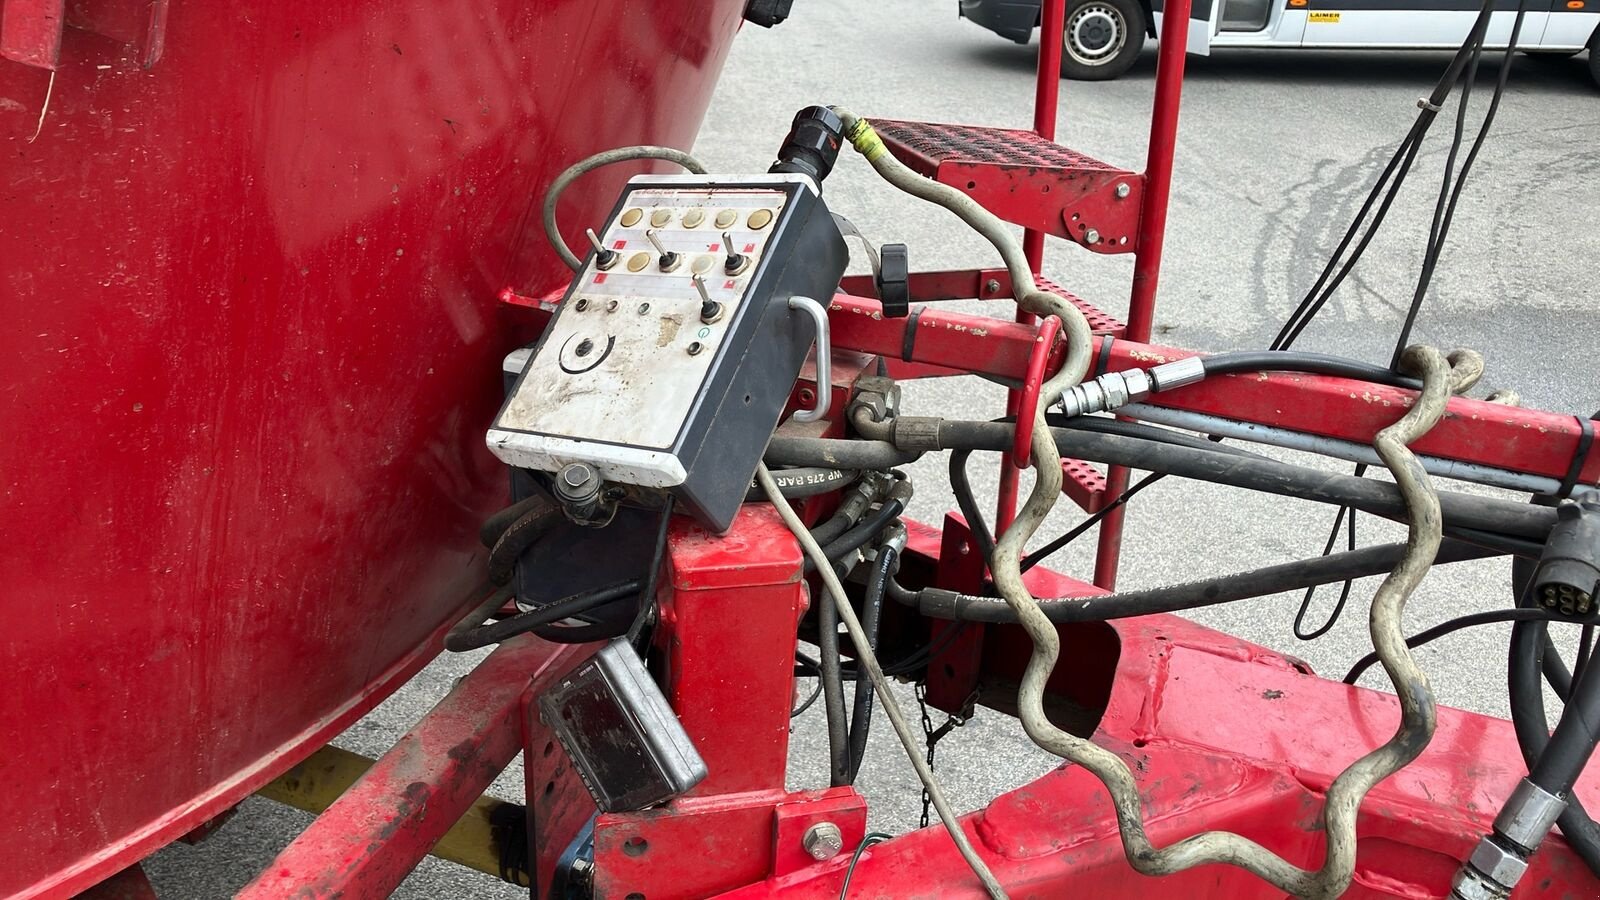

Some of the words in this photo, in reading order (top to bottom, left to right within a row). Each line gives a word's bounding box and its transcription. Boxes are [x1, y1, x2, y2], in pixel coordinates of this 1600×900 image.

[807, 473, 825, 485] 275
[828, 469, 843, 481] WP
[777, 476, 804, 487] BAR
